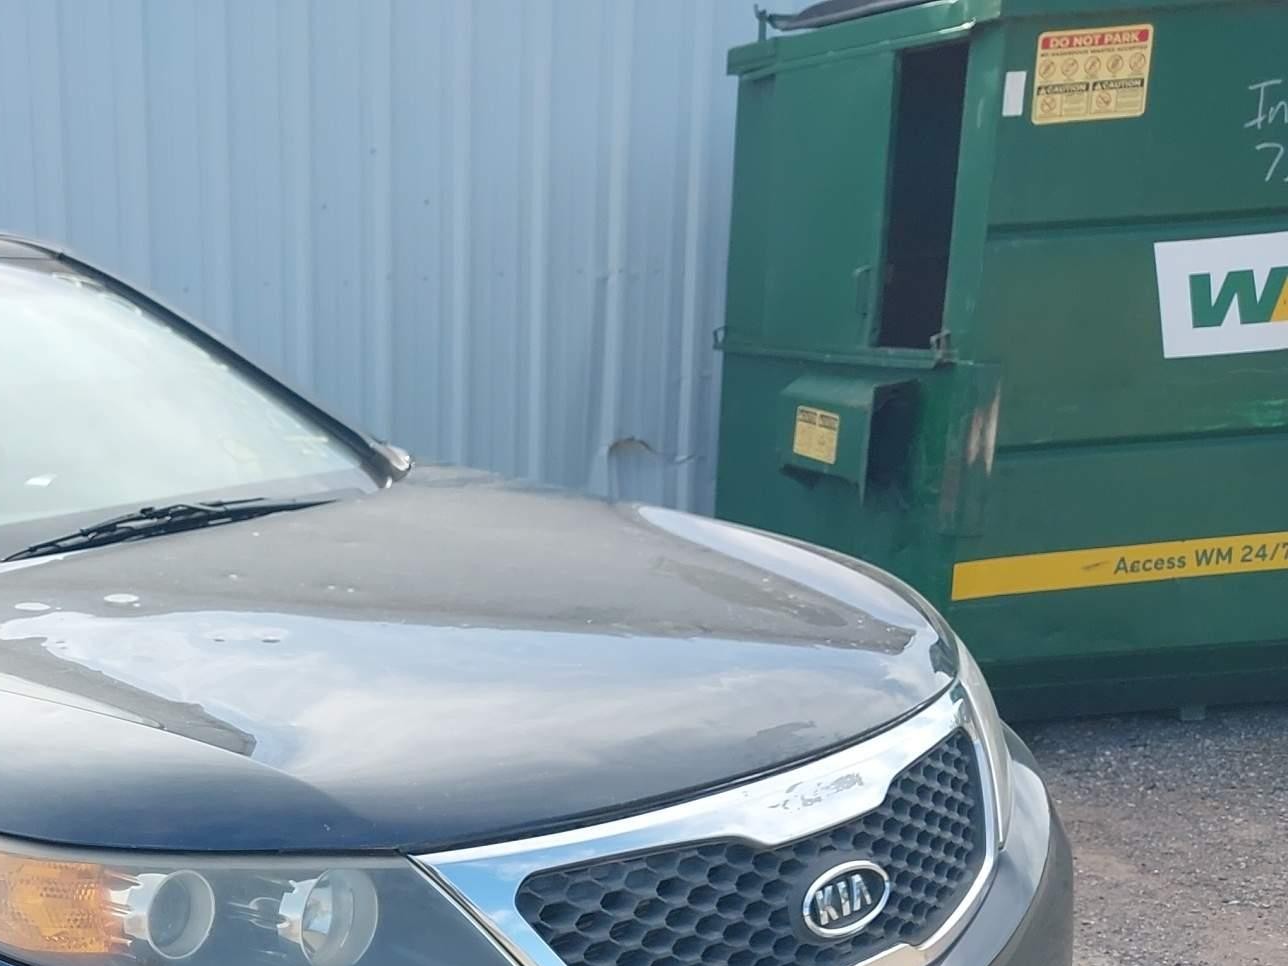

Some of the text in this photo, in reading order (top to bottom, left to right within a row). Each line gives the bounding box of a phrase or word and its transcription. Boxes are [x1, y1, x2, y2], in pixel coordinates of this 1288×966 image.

[1049, 31, 1140, 49] DO NOT PARK
[1047, 83, 1086, 94] CAUTION
[1104, 79, 1141, 91] CAUTION
[1255, 142, 1288, 182] 7
[1114, 555, 1186, 575] Access
[1195, 547, 1233, 567] WM
[815, 874, 872, 926] KIA
